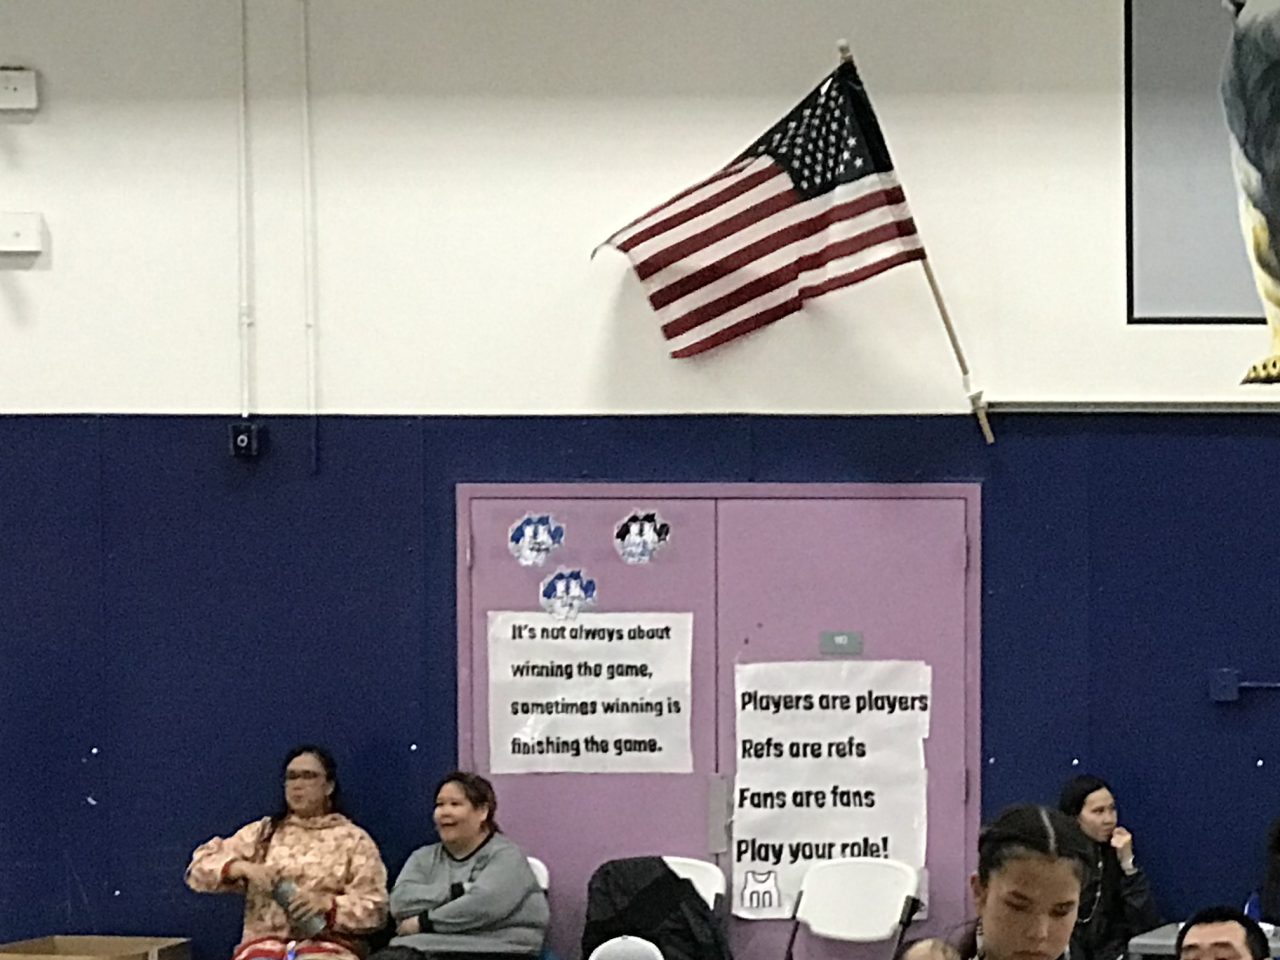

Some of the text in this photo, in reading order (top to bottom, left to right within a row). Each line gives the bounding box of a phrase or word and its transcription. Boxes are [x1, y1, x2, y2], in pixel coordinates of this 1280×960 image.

[511, 624, 671, 642] It's not always about
[511, 661, 653, 680] winning the game,
[510, 697, 681, 717] sometimes winning is
[741, 690, 928, 715] Players are players
[511, 735, 663, 757] finishing the game.
[741, 736, 867, 759] Refs are refs
[738, 785, 875, 809] Fans are fans
[736, 836, 889, 866] Play your role!
